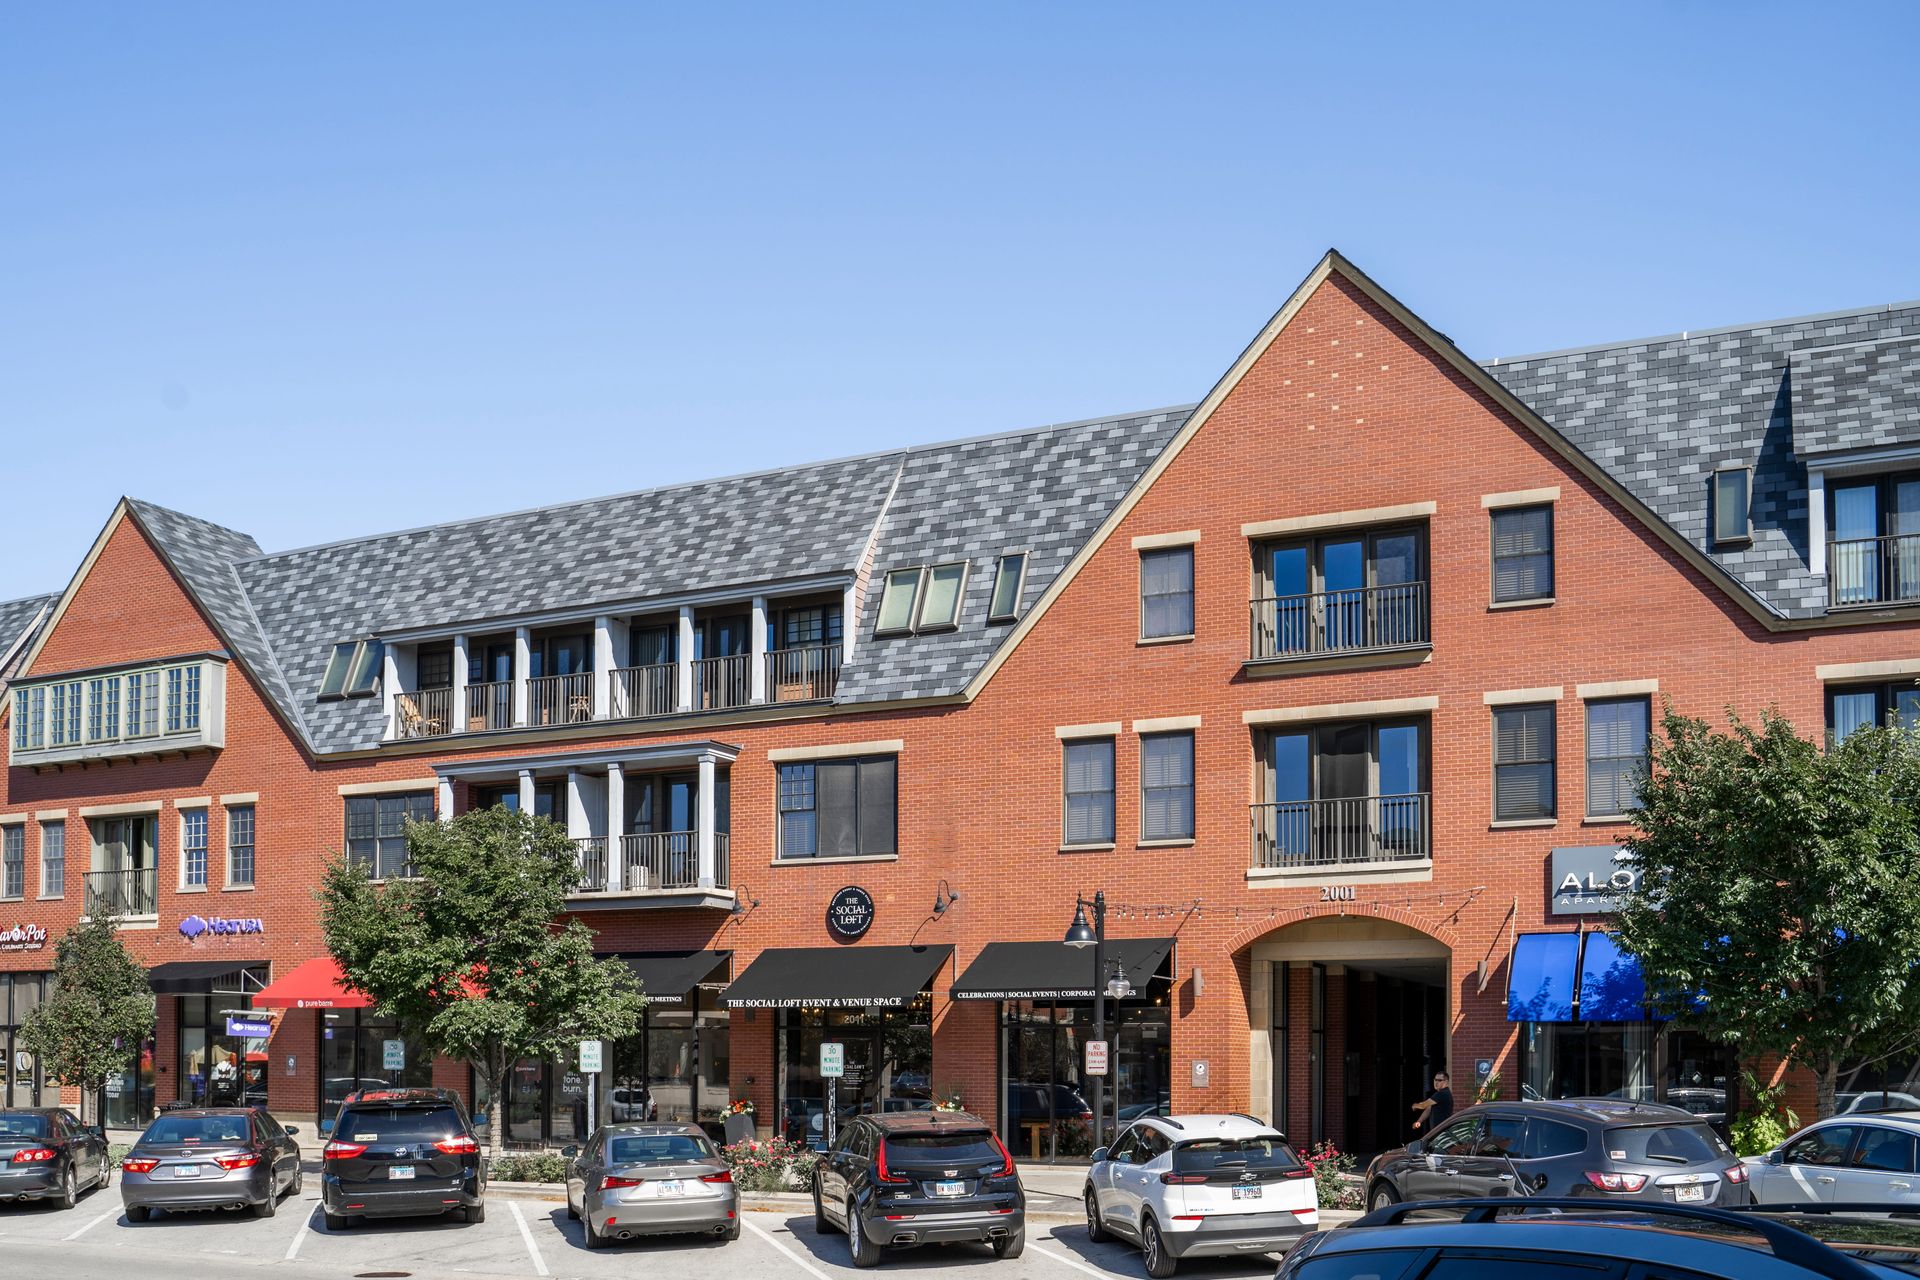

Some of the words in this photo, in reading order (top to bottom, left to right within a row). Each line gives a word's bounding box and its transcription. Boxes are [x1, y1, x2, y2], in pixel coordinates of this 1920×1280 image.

[1560, 870, 1636, 890] ALO
[1320, 886, 1355, 900] 2001
[836, 906, 868, 914] SOCIAL
[841, 915, 864, 924] LOFT
[0, 927, 27, 941] avor
[842, 998, 872, 1006] VENUE
[873, 998, 902, 1006] SPACE
[563, 1075, 583, 1084] tone.
[563, 1084, 583, 1093] burn.
